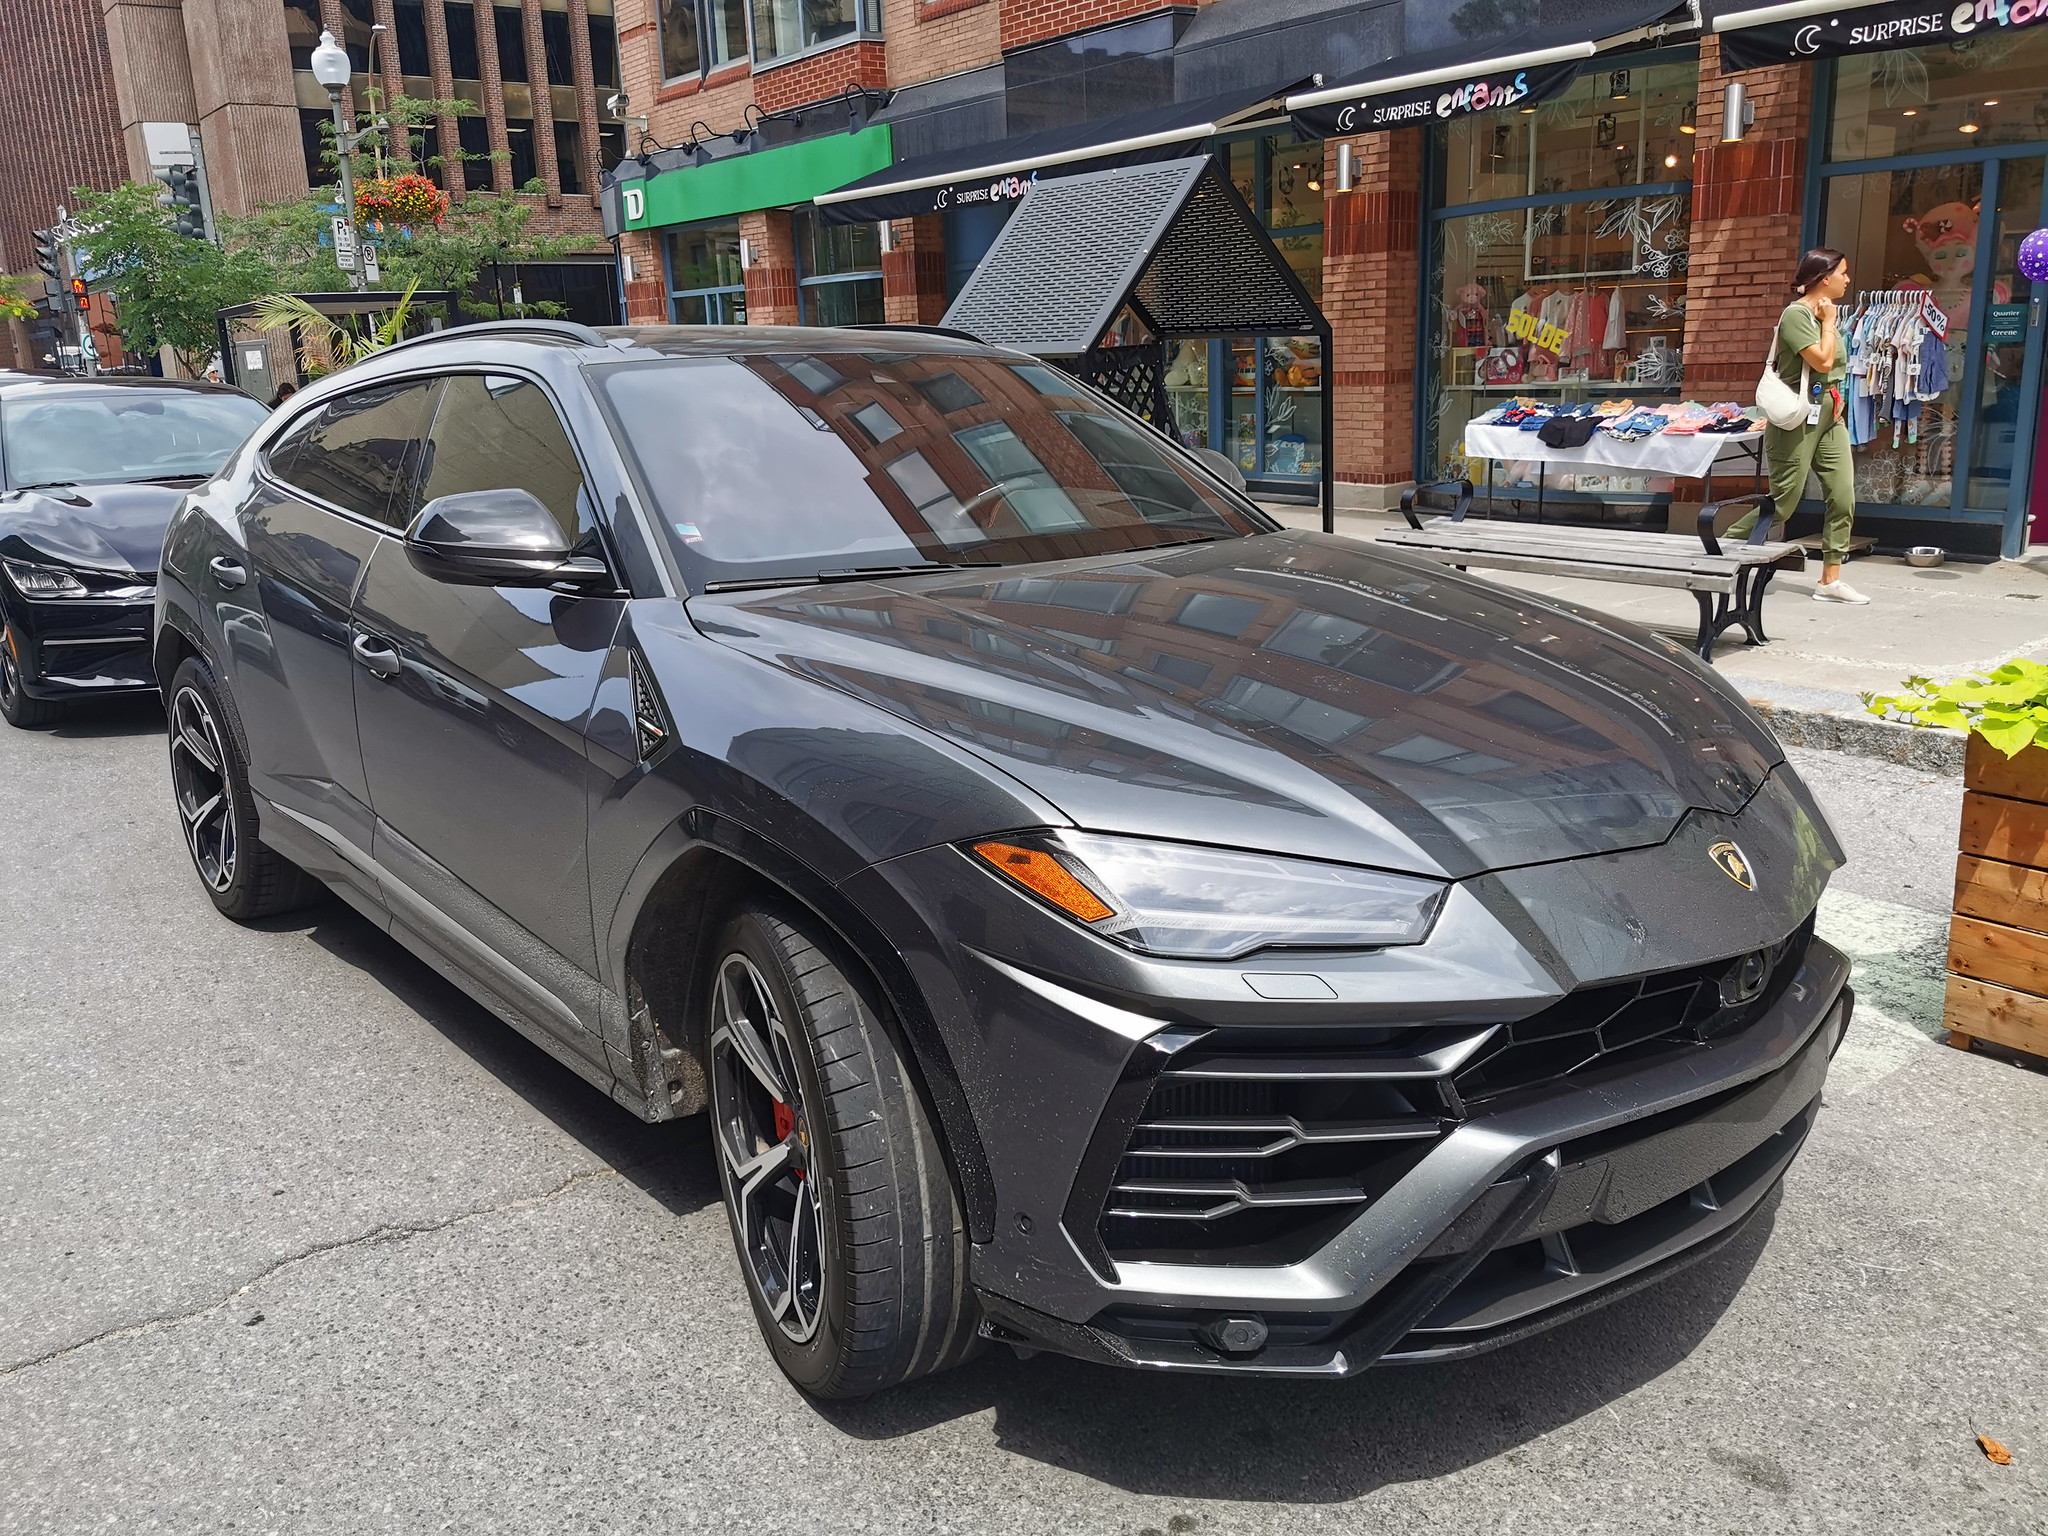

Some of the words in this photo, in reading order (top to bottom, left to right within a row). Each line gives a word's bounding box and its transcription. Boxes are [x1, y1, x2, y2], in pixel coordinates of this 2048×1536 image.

[1849, 13, 1943, 45] SURPRISE
[1372, 100, 1432, 124] SURPRISE
[1435, 72, 1529, 118] enfants
[622, 188, 644, 221] TD
[956, 188, 989, 204] SURPRISE
[1924, 302, 1945, 332] -50%
[1992, 310, 2020, 318] Quartier
[1505, 308, 1569, 356] SOLDE
[1990, 329, 2018, 337] Greene
